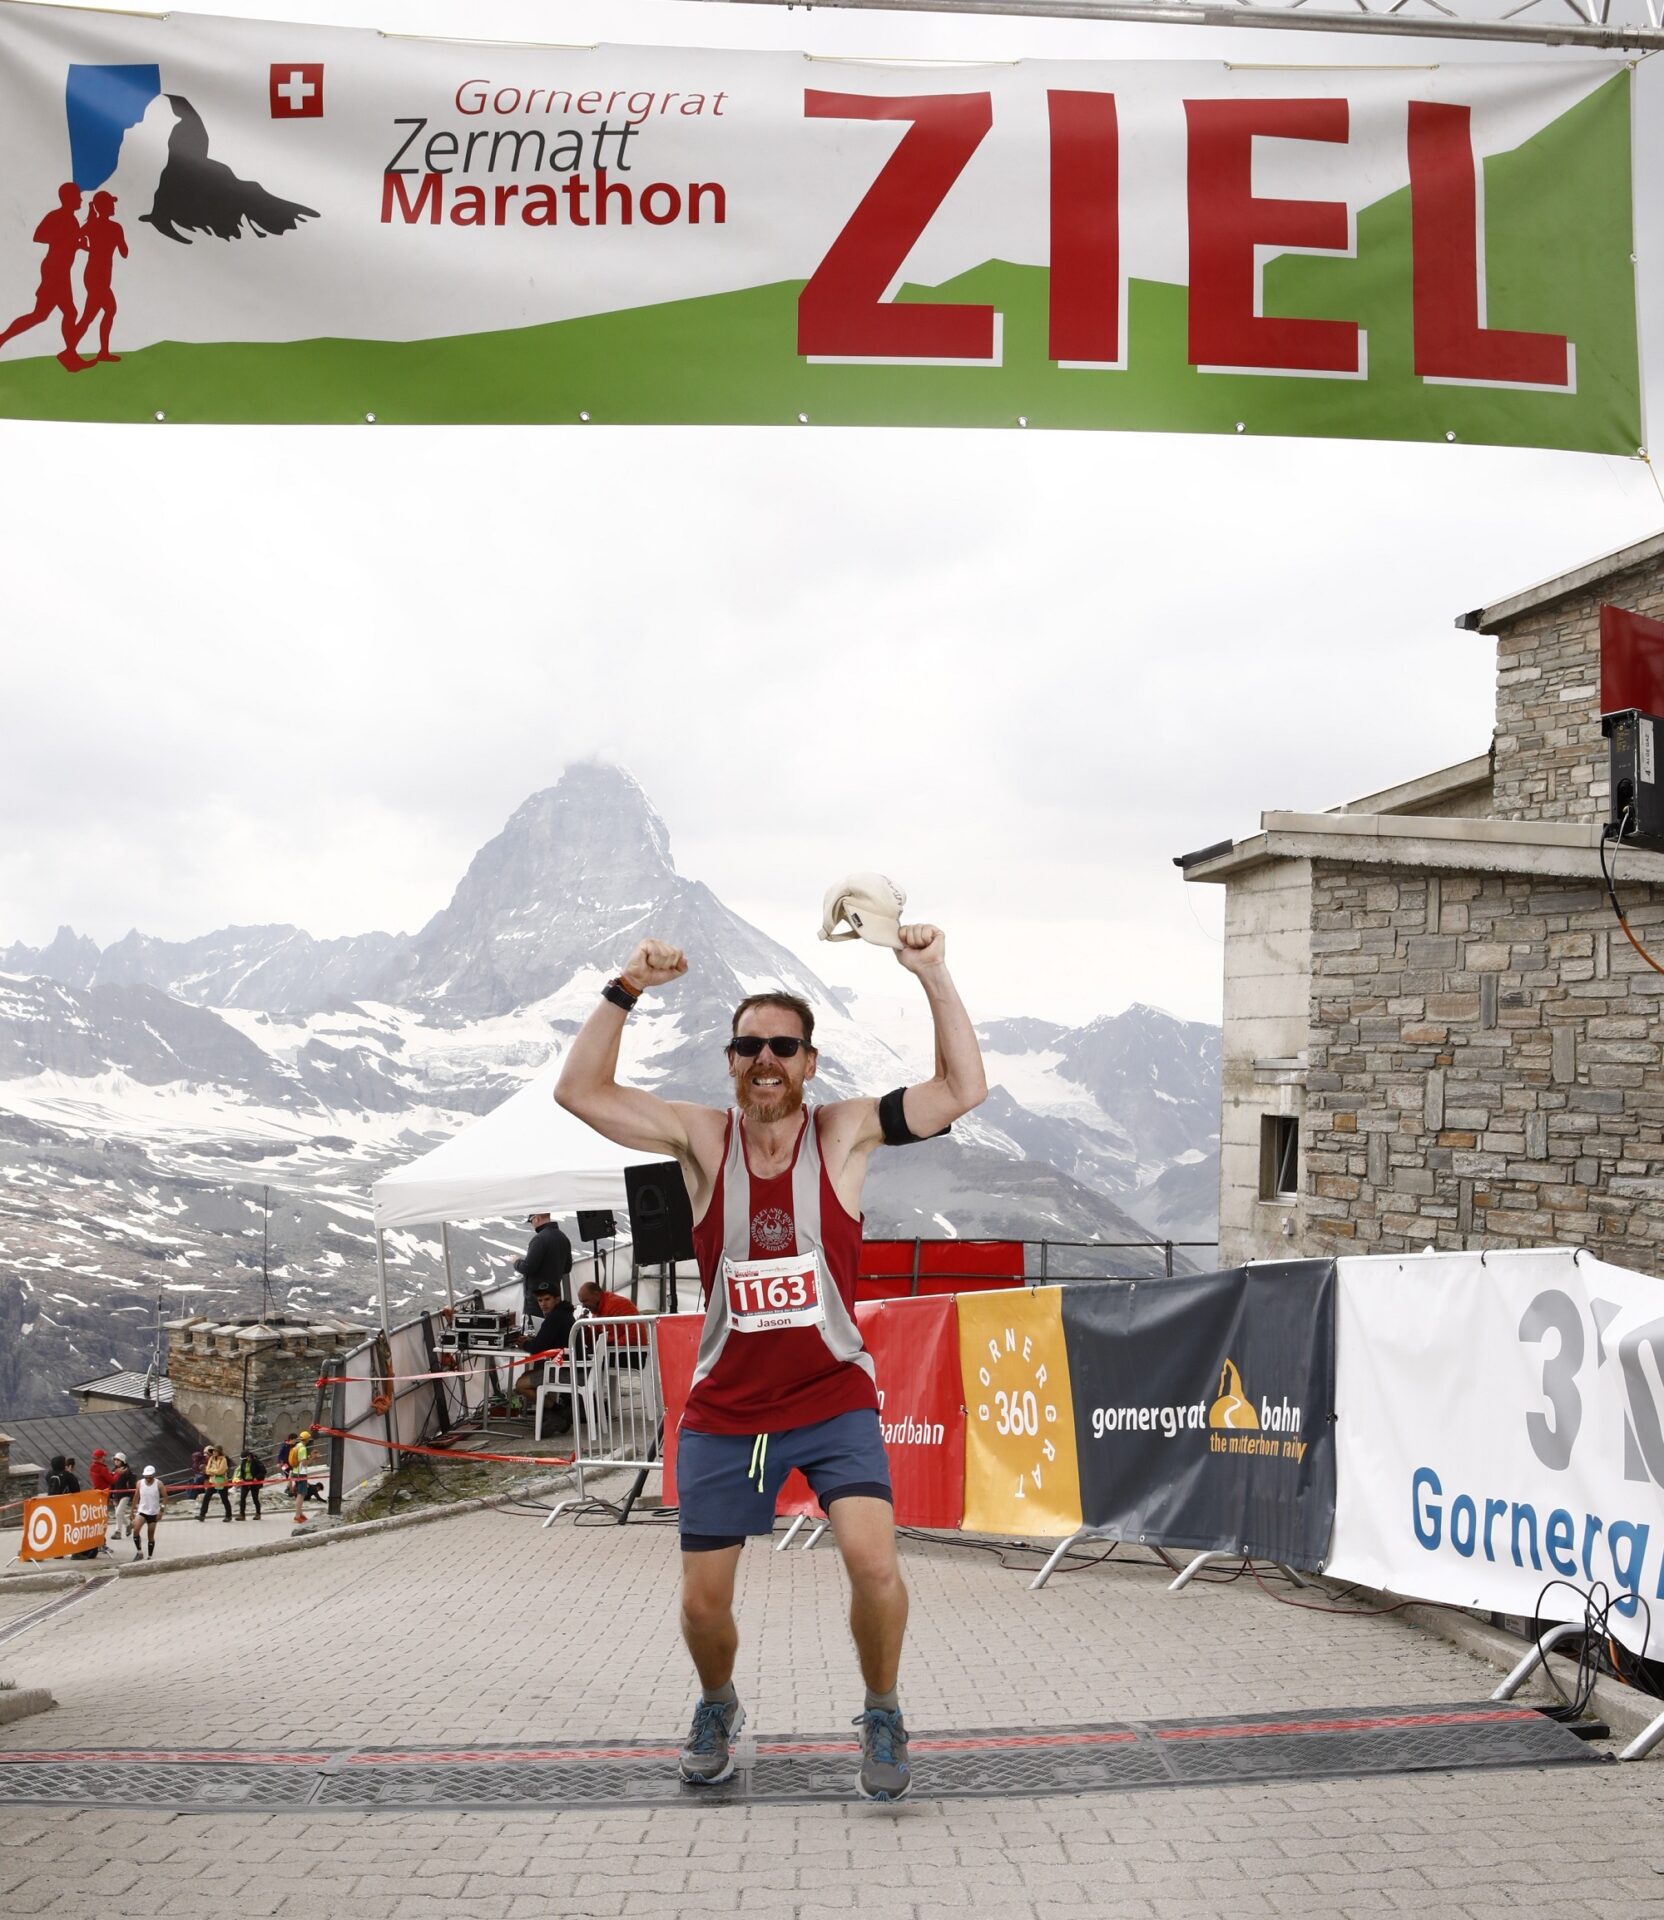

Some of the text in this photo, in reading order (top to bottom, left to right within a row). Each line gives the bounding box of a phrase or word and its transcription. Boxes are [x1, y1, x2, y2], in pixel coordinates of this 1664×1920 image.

[455, 79, 728, 125] Gornergrat
[384, 118, 639, 174] Zermatt
[380, 169, 726, 226] Marathon
[798, 89, 1576, 394] ZIEL
[734, 1276, 807, 1311] 1163
[757, 1318, 792, 1328] Jason
[978, 1327, 1057, 1498] GORNERGRAT
[994, 1390, 1039, 1437] 360
[1091, 1395, 1300, 1439] gornergrat bahn
[1210, 1432, 1227, 1453] the
